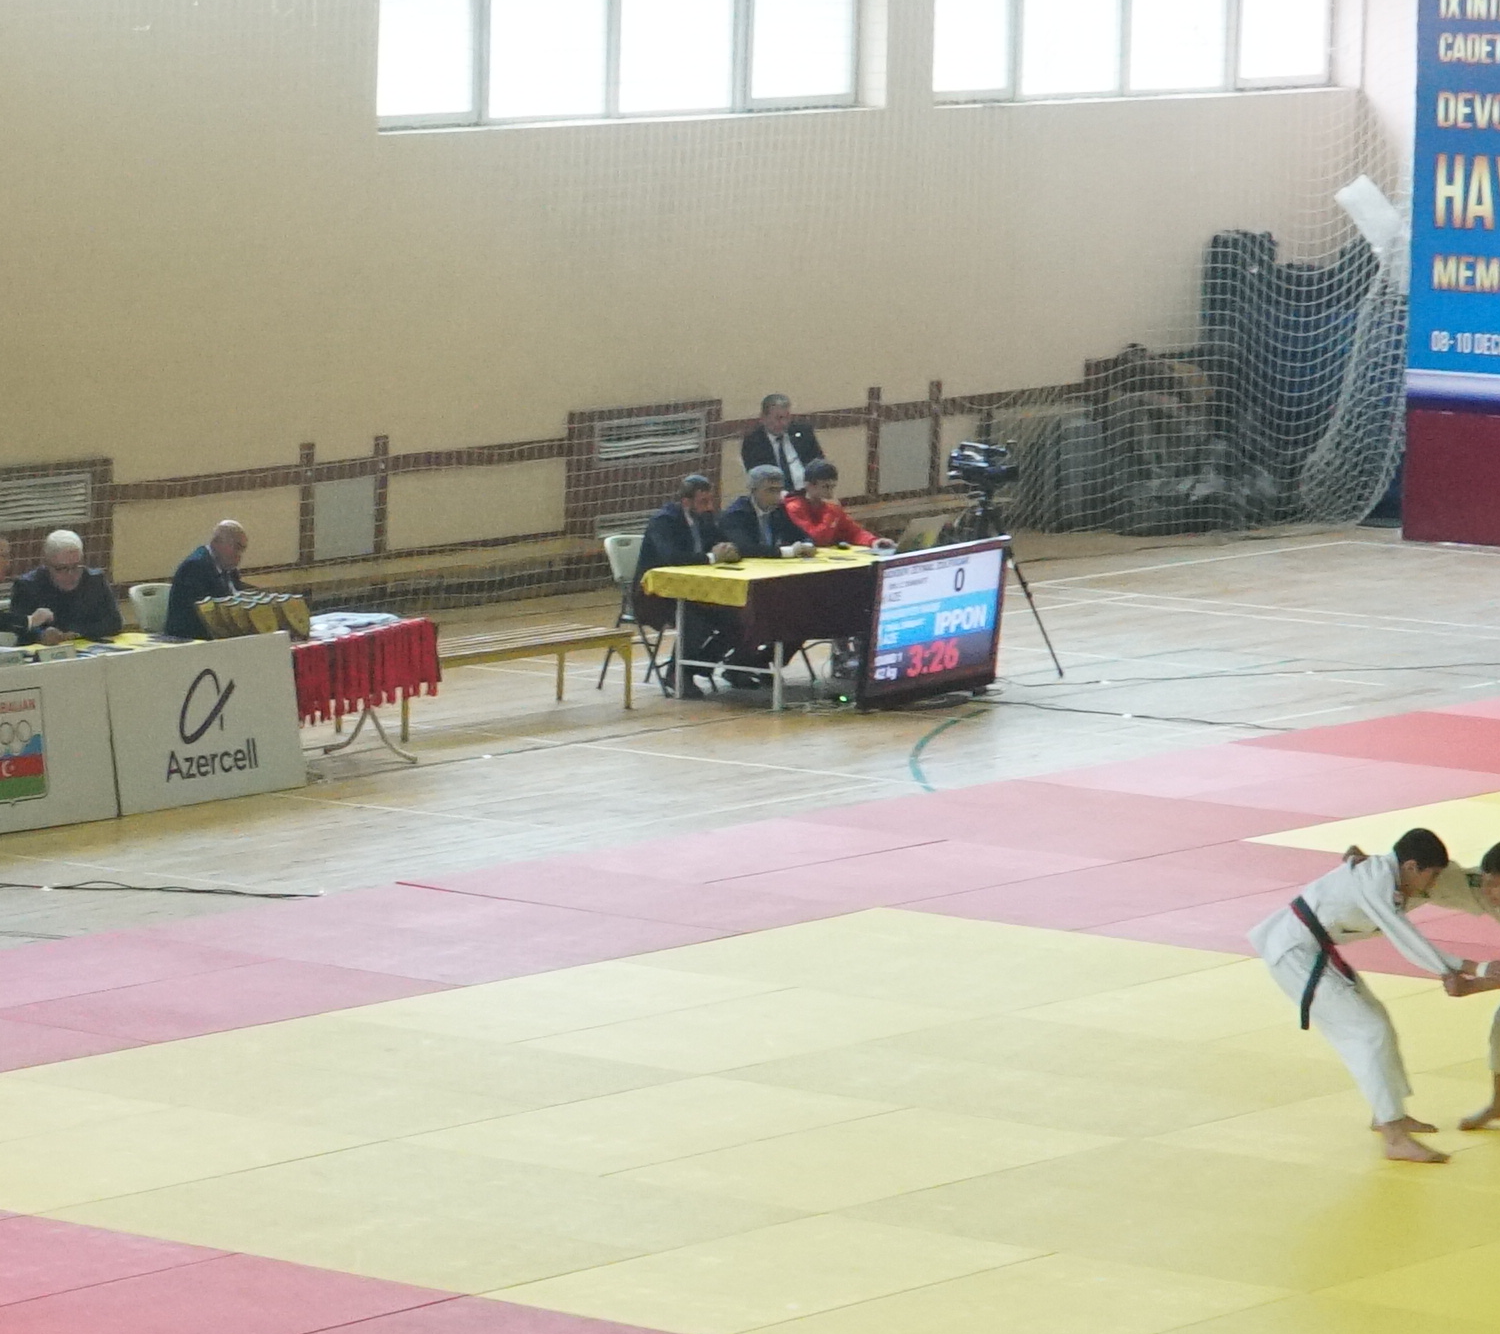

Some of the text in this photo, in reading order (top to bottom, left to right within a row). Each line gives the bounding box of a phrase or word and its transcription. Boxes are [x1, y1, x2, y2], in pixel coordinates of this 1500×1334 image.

[1431, 330, 1472, 354] 08-10
[954, 568, 965, 592] 0
[934, 604, 987, 636] IPPON
[906, 637, 960, 678] 3:26
[166, 738, 259, 783] Azercell
